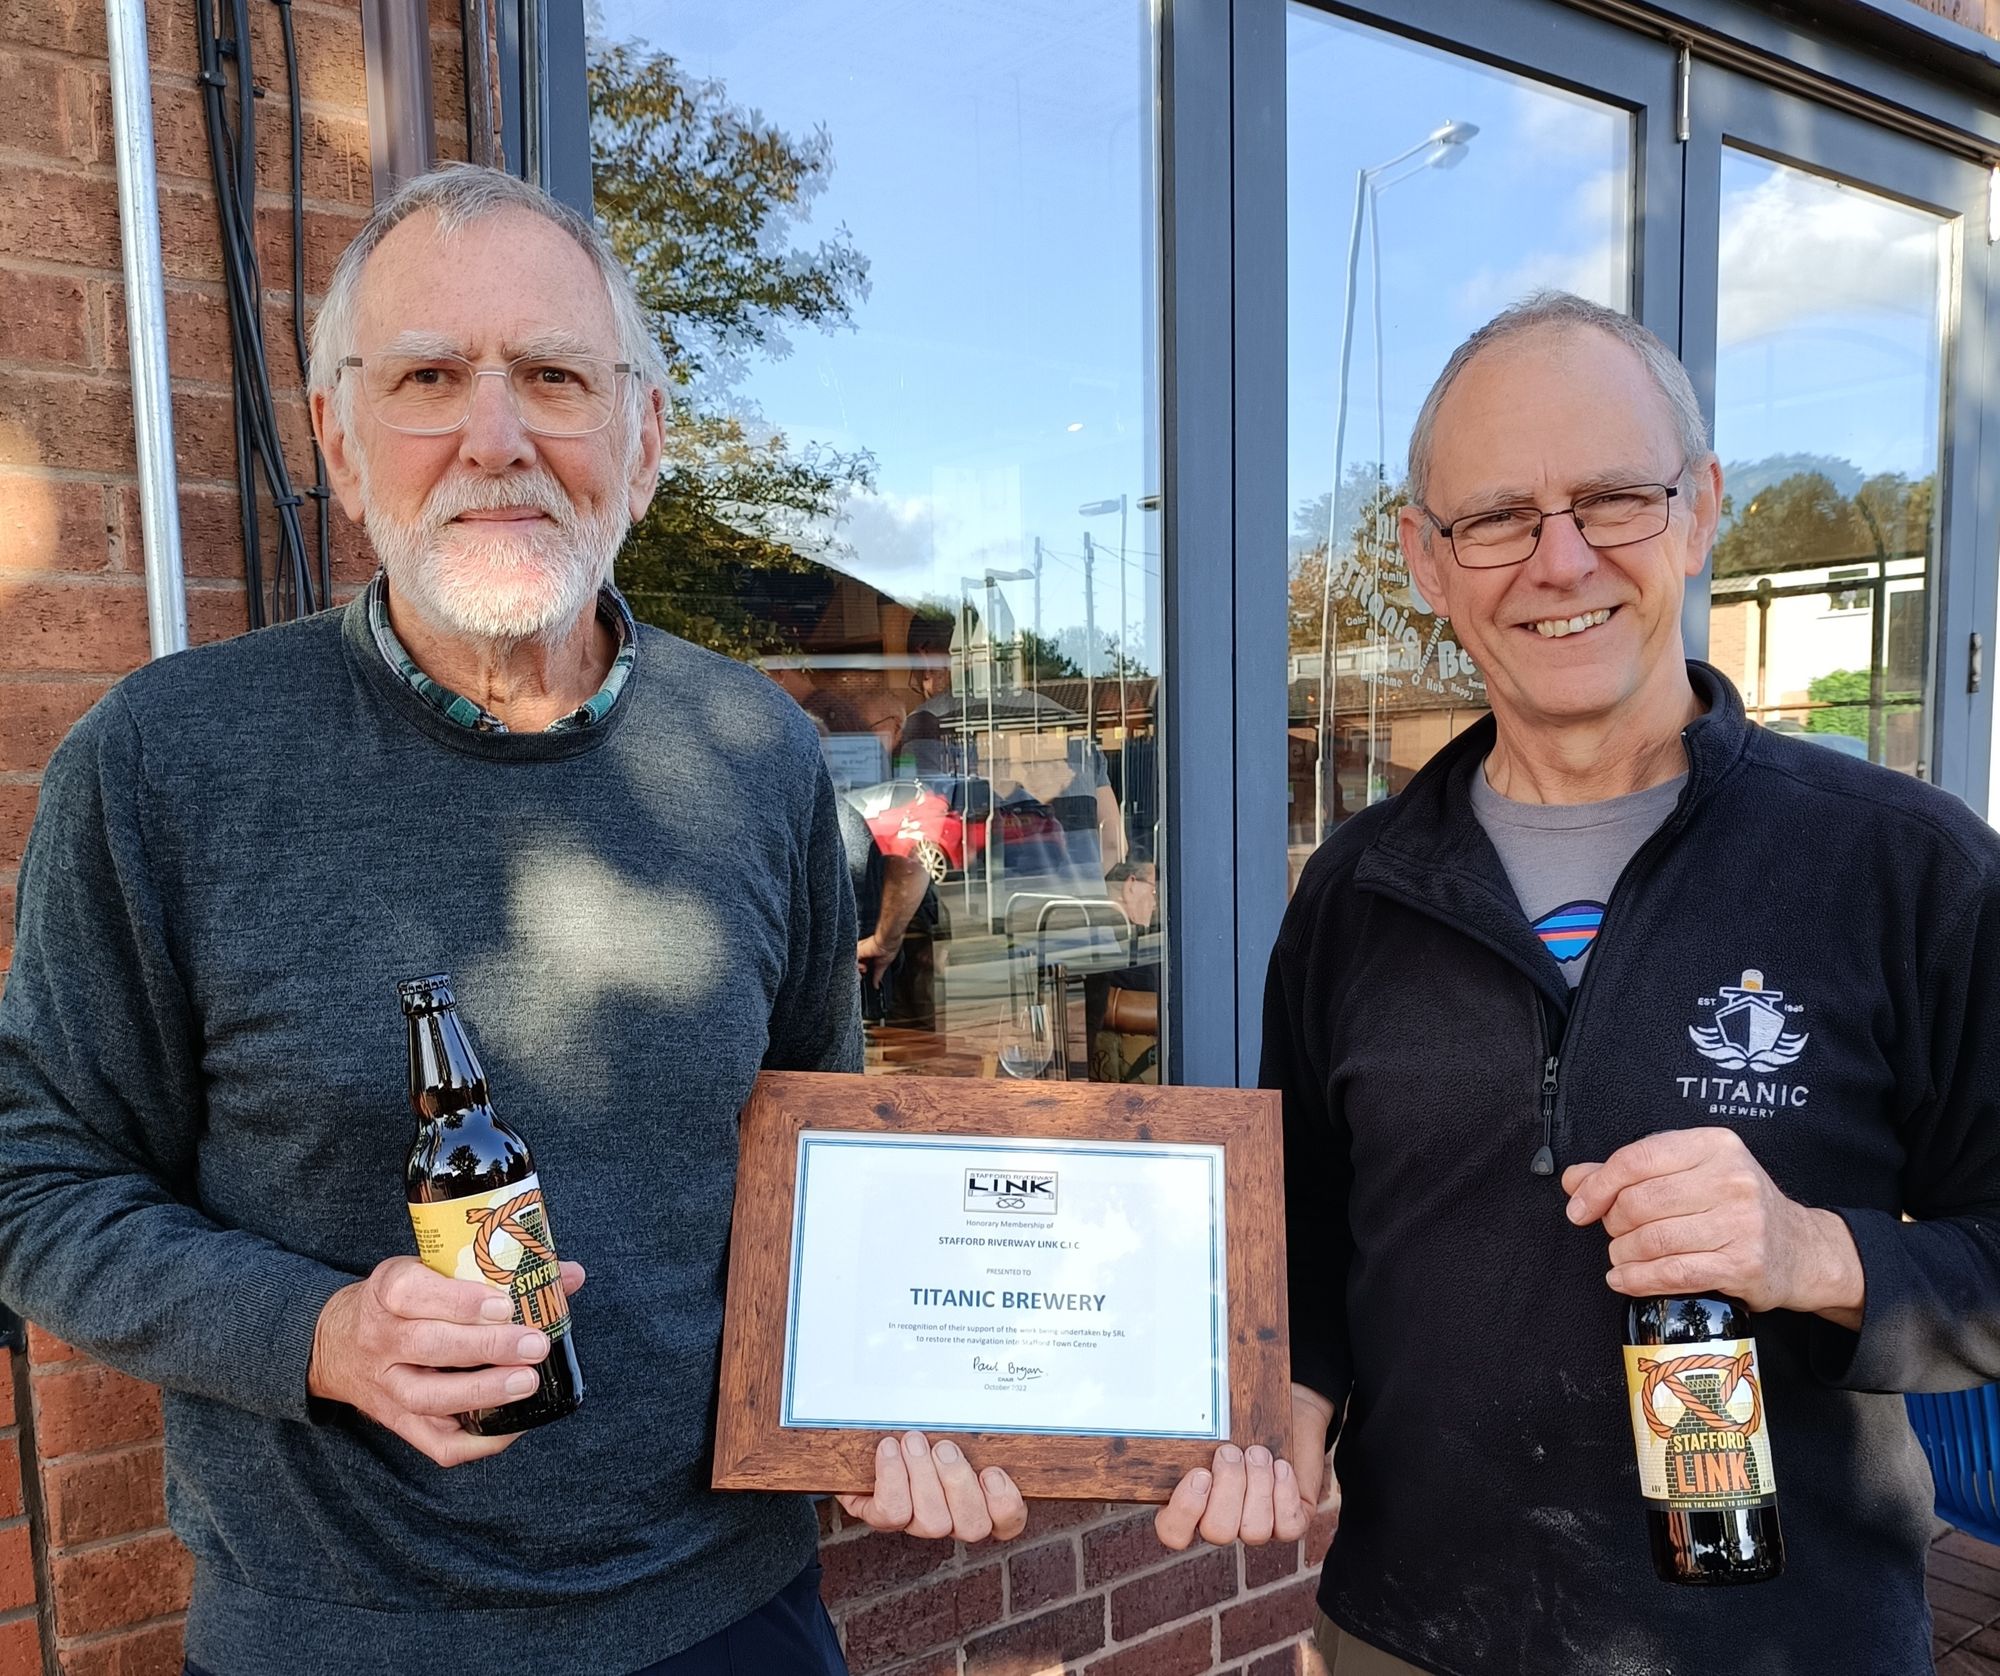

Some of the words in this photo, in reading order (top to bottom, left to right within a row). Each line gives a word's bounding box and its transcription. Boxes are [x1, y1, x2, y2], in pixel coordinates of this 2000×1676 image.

[1363, 535, 1404, 567] Lunch
[1345, 614, 1368, 626] Cake
[1411, 617, 1450, 685] Community
[1426, 677, 1445, 694] Hub
[1697, 997, 1717, 1007] EST
[1676, 1077, 1809, 1107] TITANIC
[1709, 1104, 1776, 1118] BREWERY
[970, 1172, 1012, 1180] STAFFORD
[969, 1178, 1054, 1194] LINK
[966, 1219, 999, 1229] Honorary
[1000, 1221, 1045, 1230] Membership
[938, 1236, 986, 1247] STAFFORD
[987, 1238, 1036, 1249] RIVERWAY
[1037, 1240, 1058, 1249] LINK
[986, 1268, 1022, 1276] PRESENTED
[909, 1288, 996, 1309] TITANIC
[1002, 1291, 1107, 1312] BREWERY
[897, 1323, 938, 1332] recognition
[939, 1323, 947, 1331] of
[948, 1324, 966, 1332] their
[967, 1325, 995, 1334] support
[1005, 1326, 1017, 1334] the
[1060, 1329, 1101, 1337] undertaken
[1102, 1329, 1112, 1338] by
[925, 1336, 952, 1344] restore
[953, 1336, 966, 1344] the
[966, 1337, 1005, 1346] navigation
[1052, 1339, 1072, 1347] Town
[1073, 1340, 1098, 1349] Centre
[973, 1355, 999, 1371] Paul
[984, 1383, 1011, 1391] October
[1673, 1431, 1746, 1453] STAFFORD
[1675, 1451, 1752, 1493] LINK
